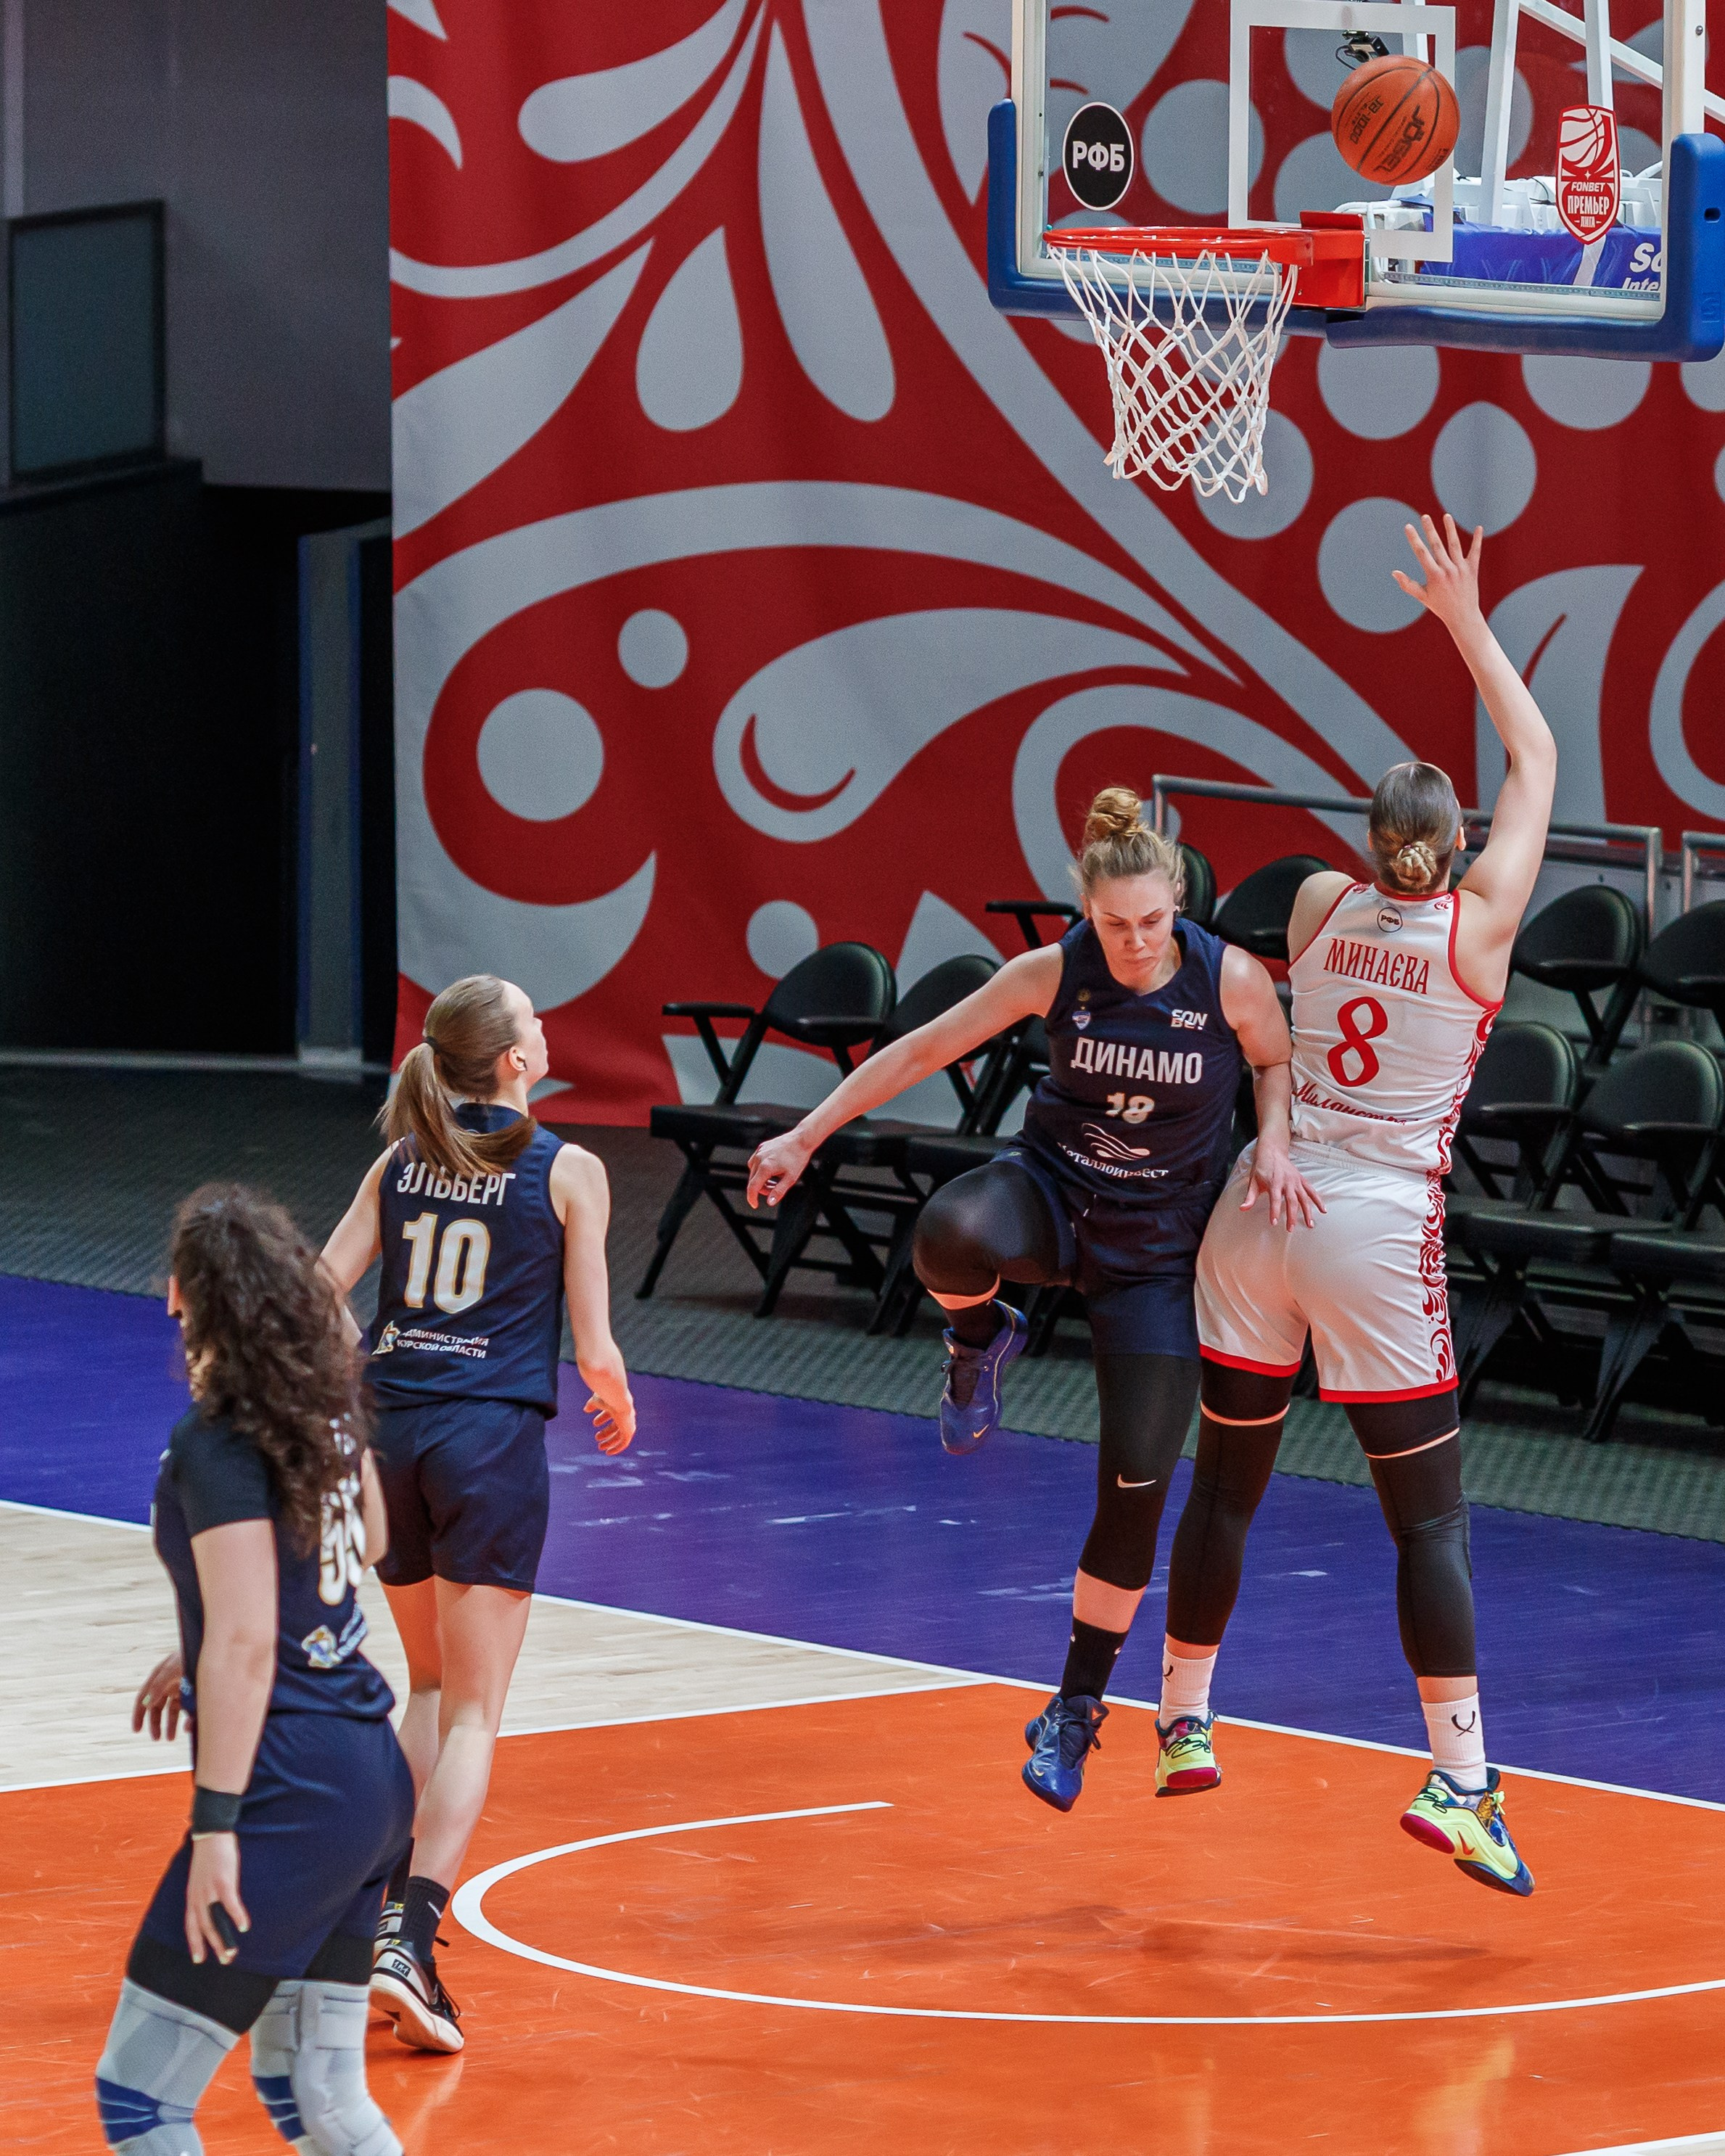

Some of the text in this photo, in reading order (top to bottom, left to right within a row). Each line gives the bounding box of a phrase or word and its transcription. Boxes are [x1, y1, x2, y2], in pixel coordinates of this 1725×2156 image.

[1072, 141, 1125, 172] РФБ
[1570, 181, 1606, 192] FONBET
[1567, 195, 1610, 215] ПРЕМЬЕР
[1380, 914, 1400, 925] РФБ
[1327, 996, 1388, 1087] 8
[1070, 1037, 1203, 1085] ДИНАМО
[1105, 1092, 1155, 1124] 18
[402, 1212, 491, 1314] 10
[397, 1339, 440, 1351] КУРСКОЙ
